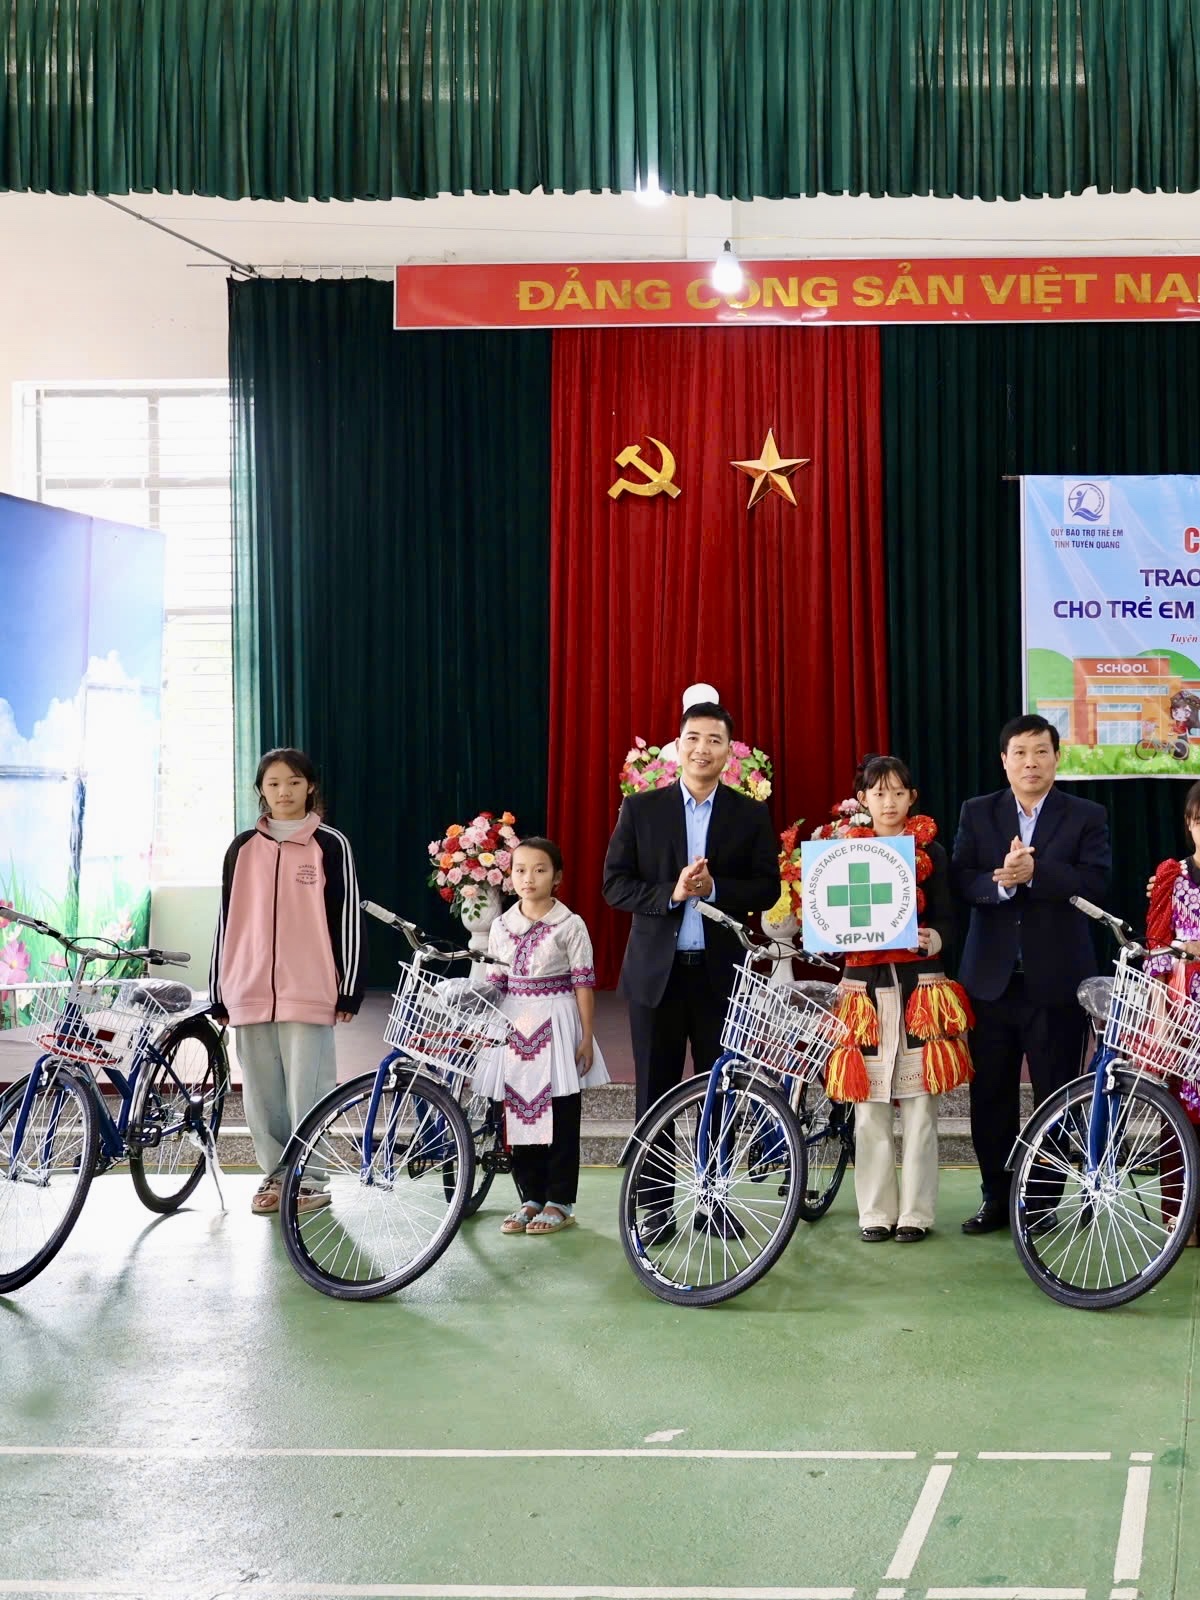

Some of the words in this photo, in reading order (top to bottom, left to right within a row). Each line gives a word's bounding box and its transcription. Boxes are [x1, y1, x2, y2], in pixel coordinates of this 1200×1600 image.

[516, 266, 671, 310] ĐẢNG
[853, 263, 964, 306] SẢN
[982, 266, 1098, 311] VIỆT
[1053, 600, 1102, 619] CHO
[1107, 595, 1153, 619] TRẺ
[1158, 601, 1195, 619] EM
[1096, 663, 1149, 673] SCHOOL
[850, 843, 898, 865] PROGRAM
[808, 846, 848, 896] ASSISTANCE
[895, 864, 909, 884] FOR
[808, 899, 830, 931] SOCIAL
[890, 886, 911, 928] VIETNAM
[835, 931, 885, 945] SAP-VN
